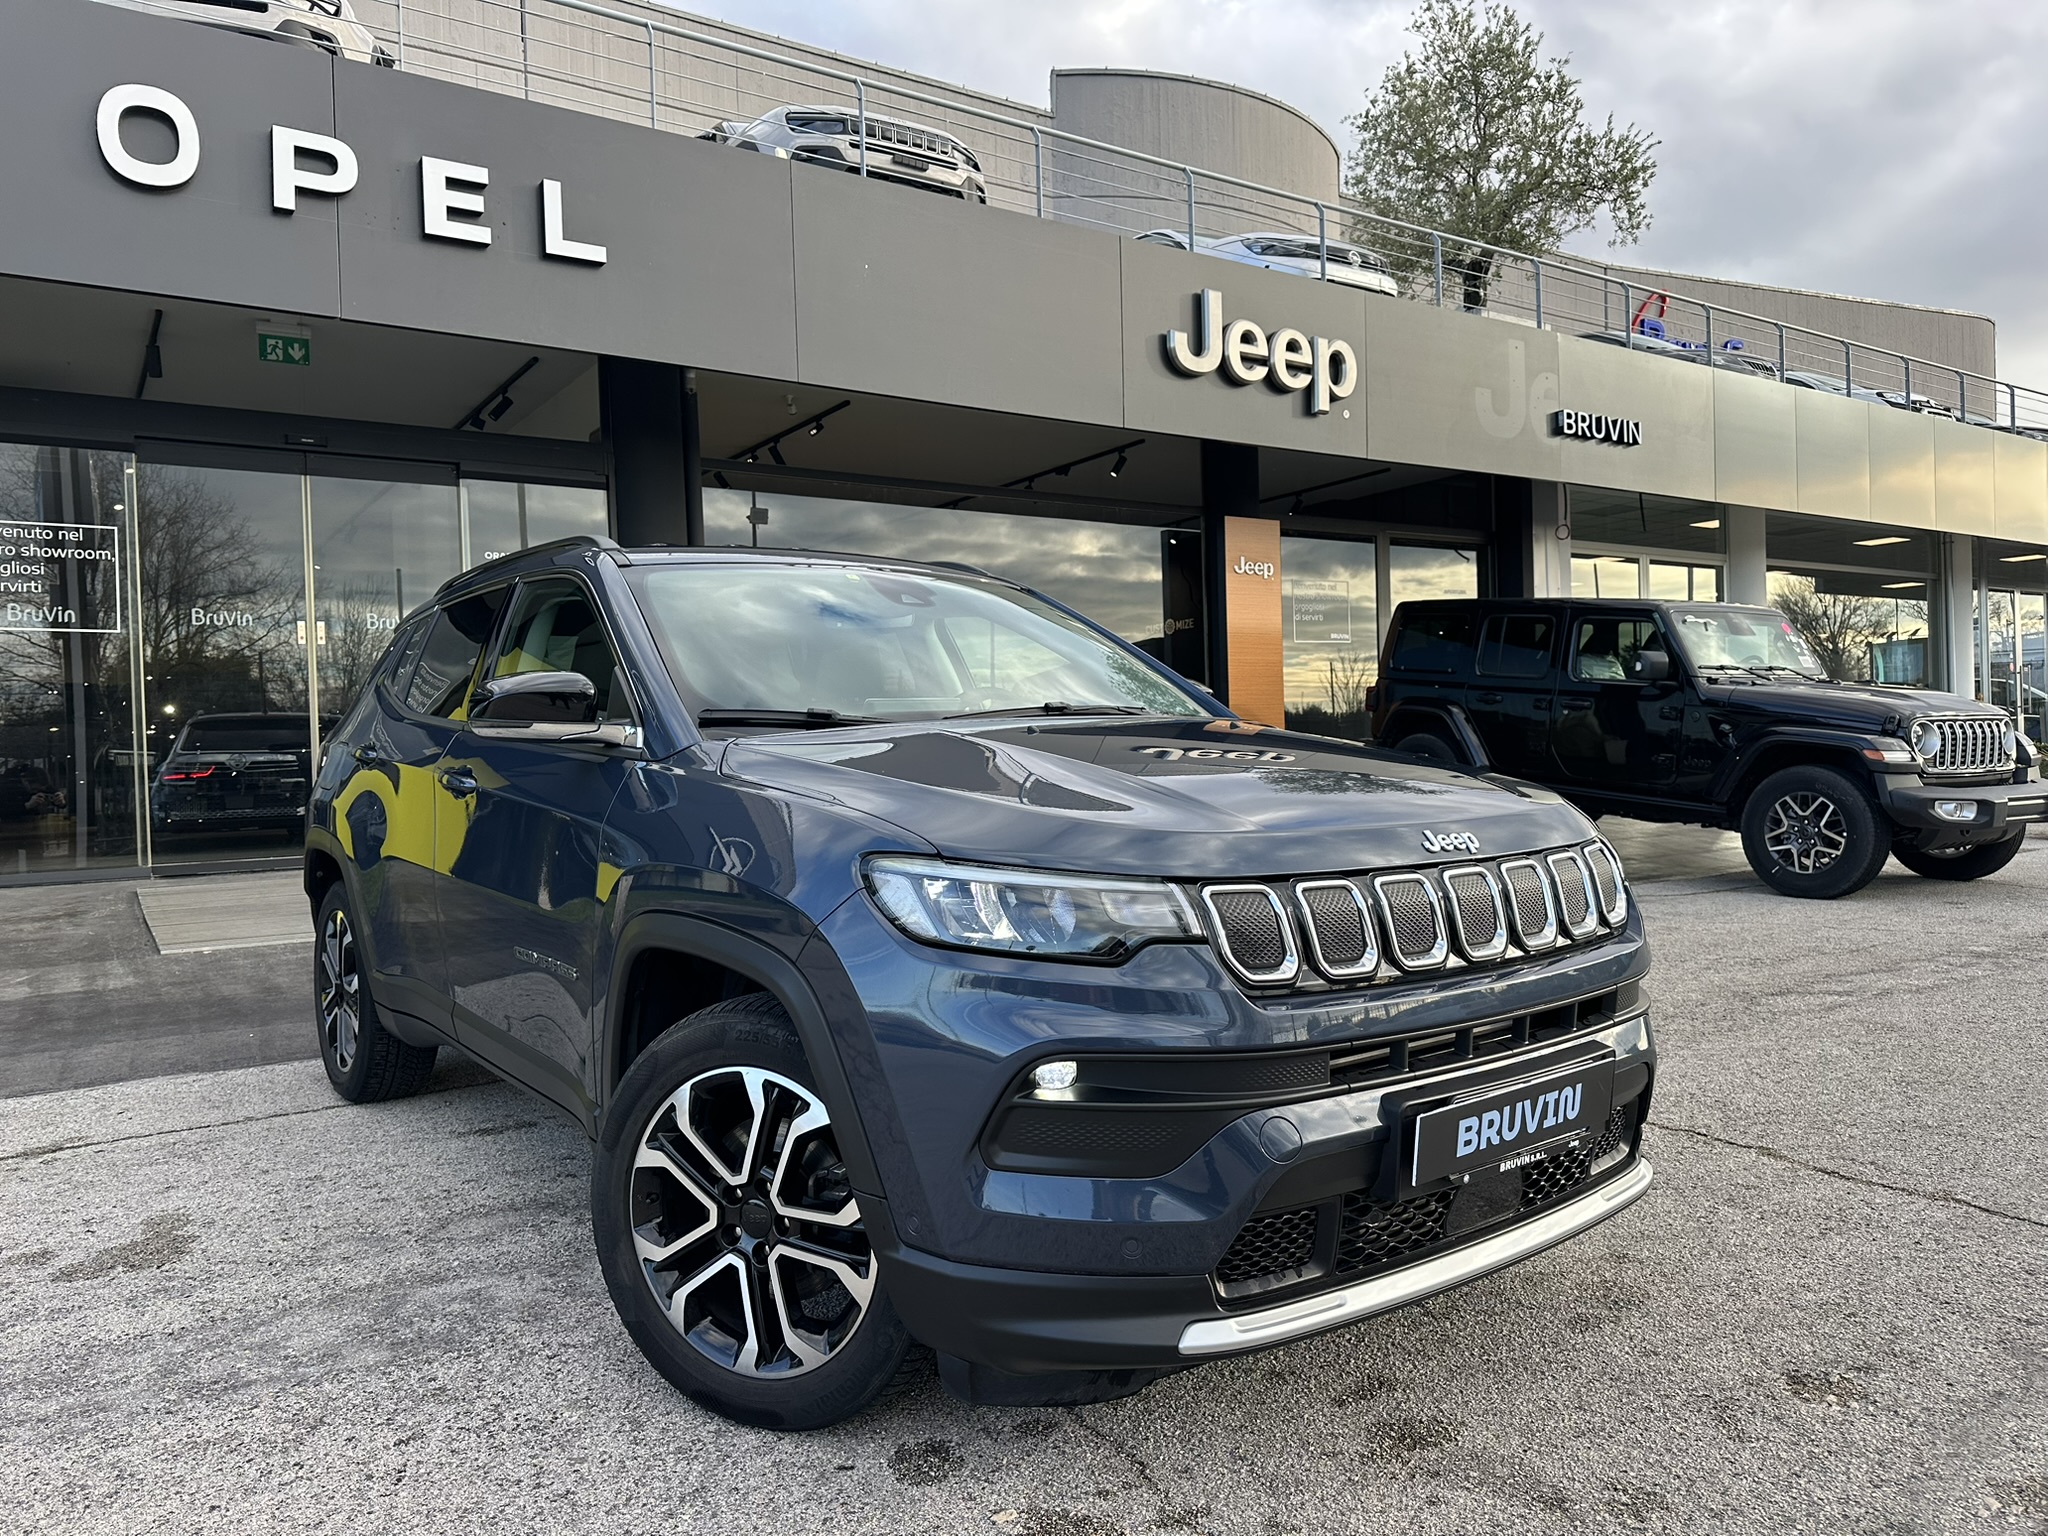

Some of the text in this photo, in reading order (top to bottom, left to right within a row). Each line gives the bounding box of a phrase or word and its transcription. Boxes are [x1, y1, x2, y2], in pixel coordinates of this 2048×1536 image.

[96, 83, 608, 267] OPEL
[1166, 287, 1358, 416] Jeep
[1562, 408, 1643, 445] BRUVIN
[58, 527, 84, 541] nel
[20, 543, 115, 563] showroom,
[0, 560, 45, 577] gliosi
[1233, 555, 1275, 580] Jeep
[7, 602, 76, 623] BruVin
[190, 607, 253, 626] BruVin
[1421, 829, 1481, 854] Jeep
[1456, 1082, 1583, 1158] BRUVIN
[1499, 1154, 1531, 1173] BRUVIN
